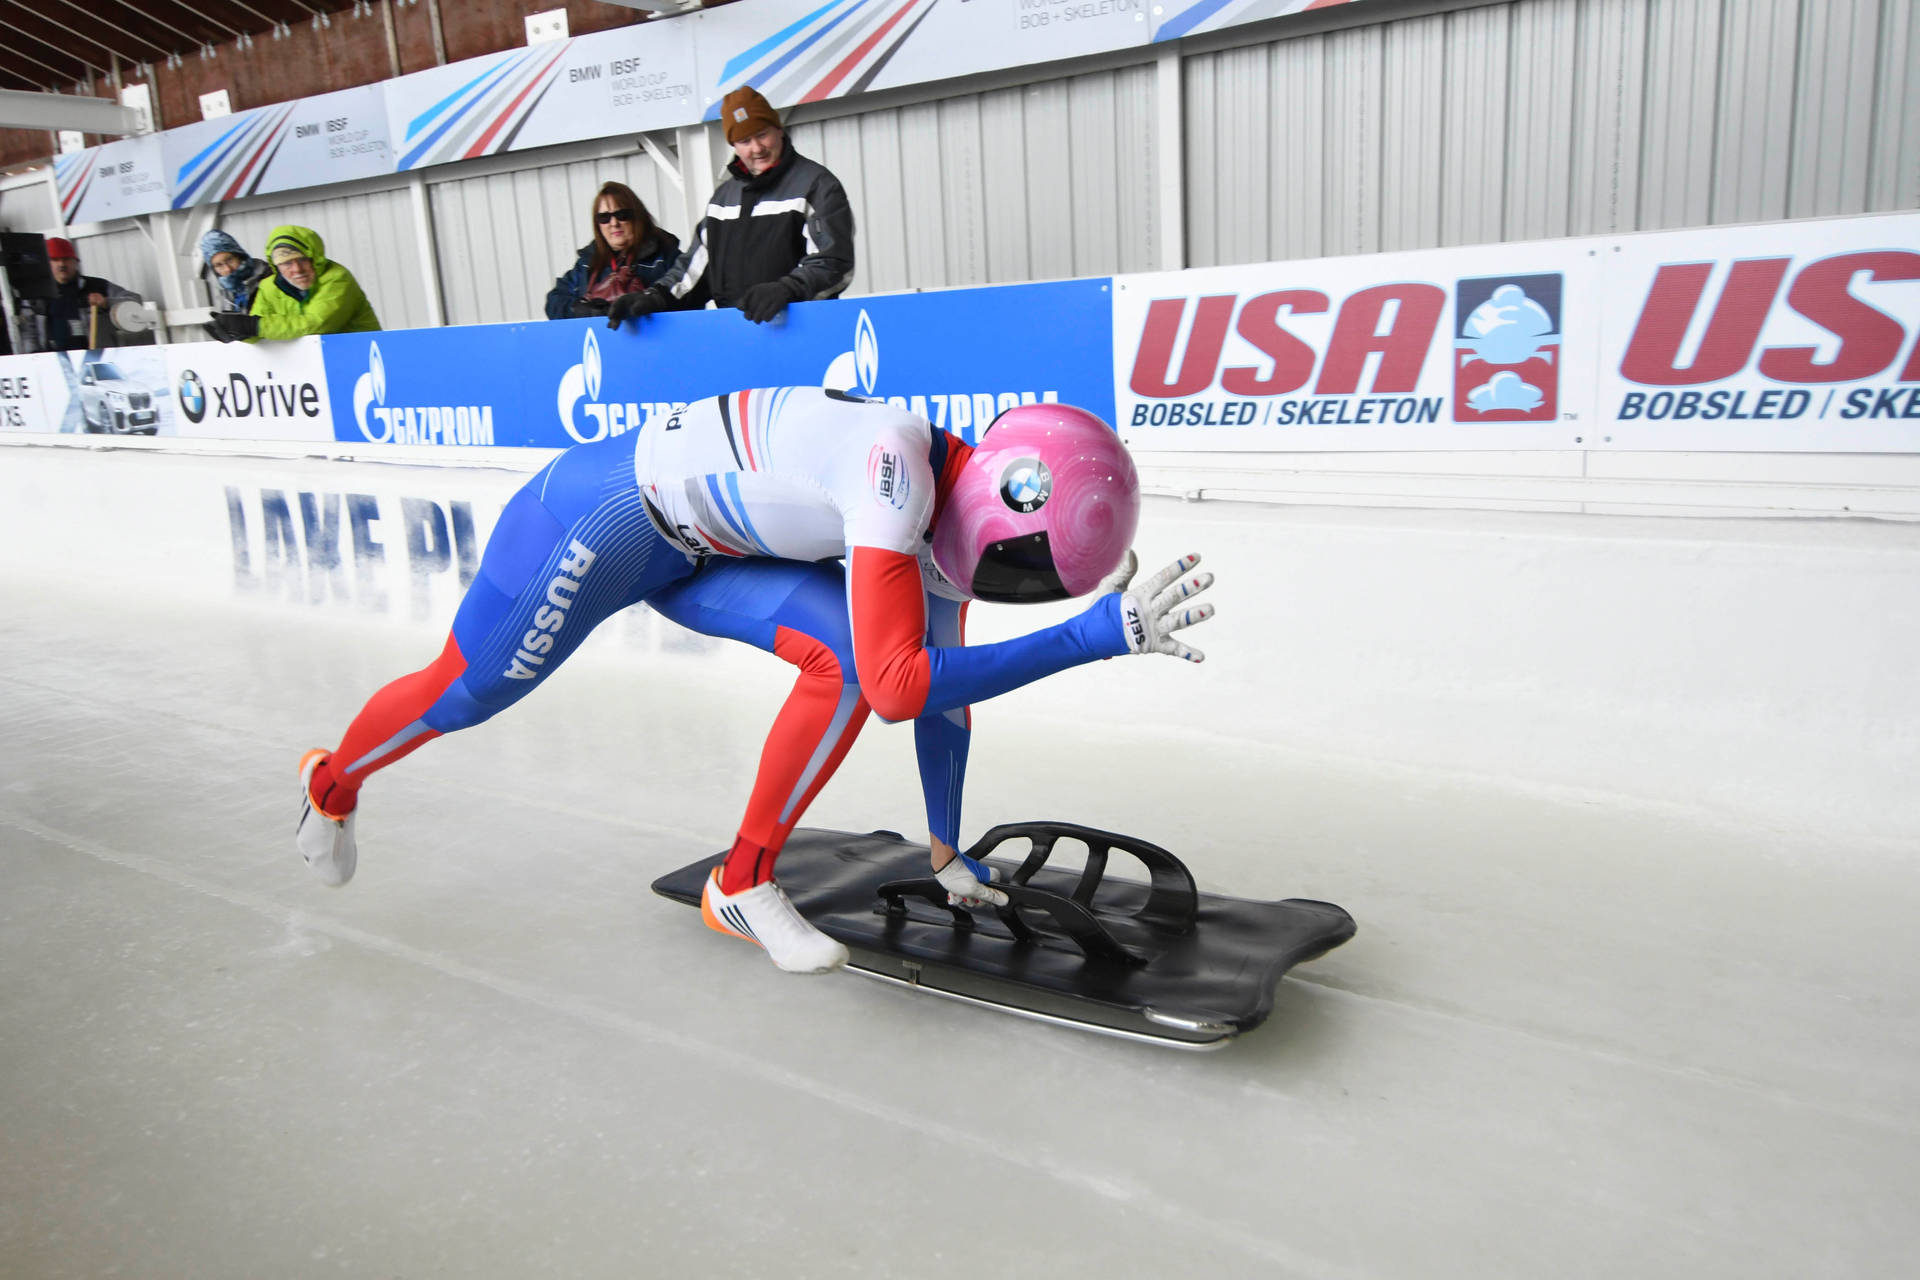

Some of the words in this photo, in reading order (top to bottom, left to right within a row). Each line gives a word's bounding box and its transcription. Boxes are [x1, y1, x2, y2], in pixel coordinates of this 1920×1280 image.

[569, 64, 602, 83] BMW
[610, 57, 641, 76] IBSF
[296, 123, 320, 138] BMW
[1618, 248, 1920, 387] US
[1129, 280, 1447, 398] USA
[213, 370, 320, 418] xDrive
[1131, 401, 1257, 427] BOBSLED
[1277, 397, 1444, 425] SKELETON
[1617, 390, 1812, 420] BOBSLED
[1840, 388, 1920, 419] SKE
[391, 405, 495, 446] GAZPROM
[880, 452, 893, 498] IBSF
[677, 524, 713, 557] Lak
[502, 538, 597, 680] RUSSIA
